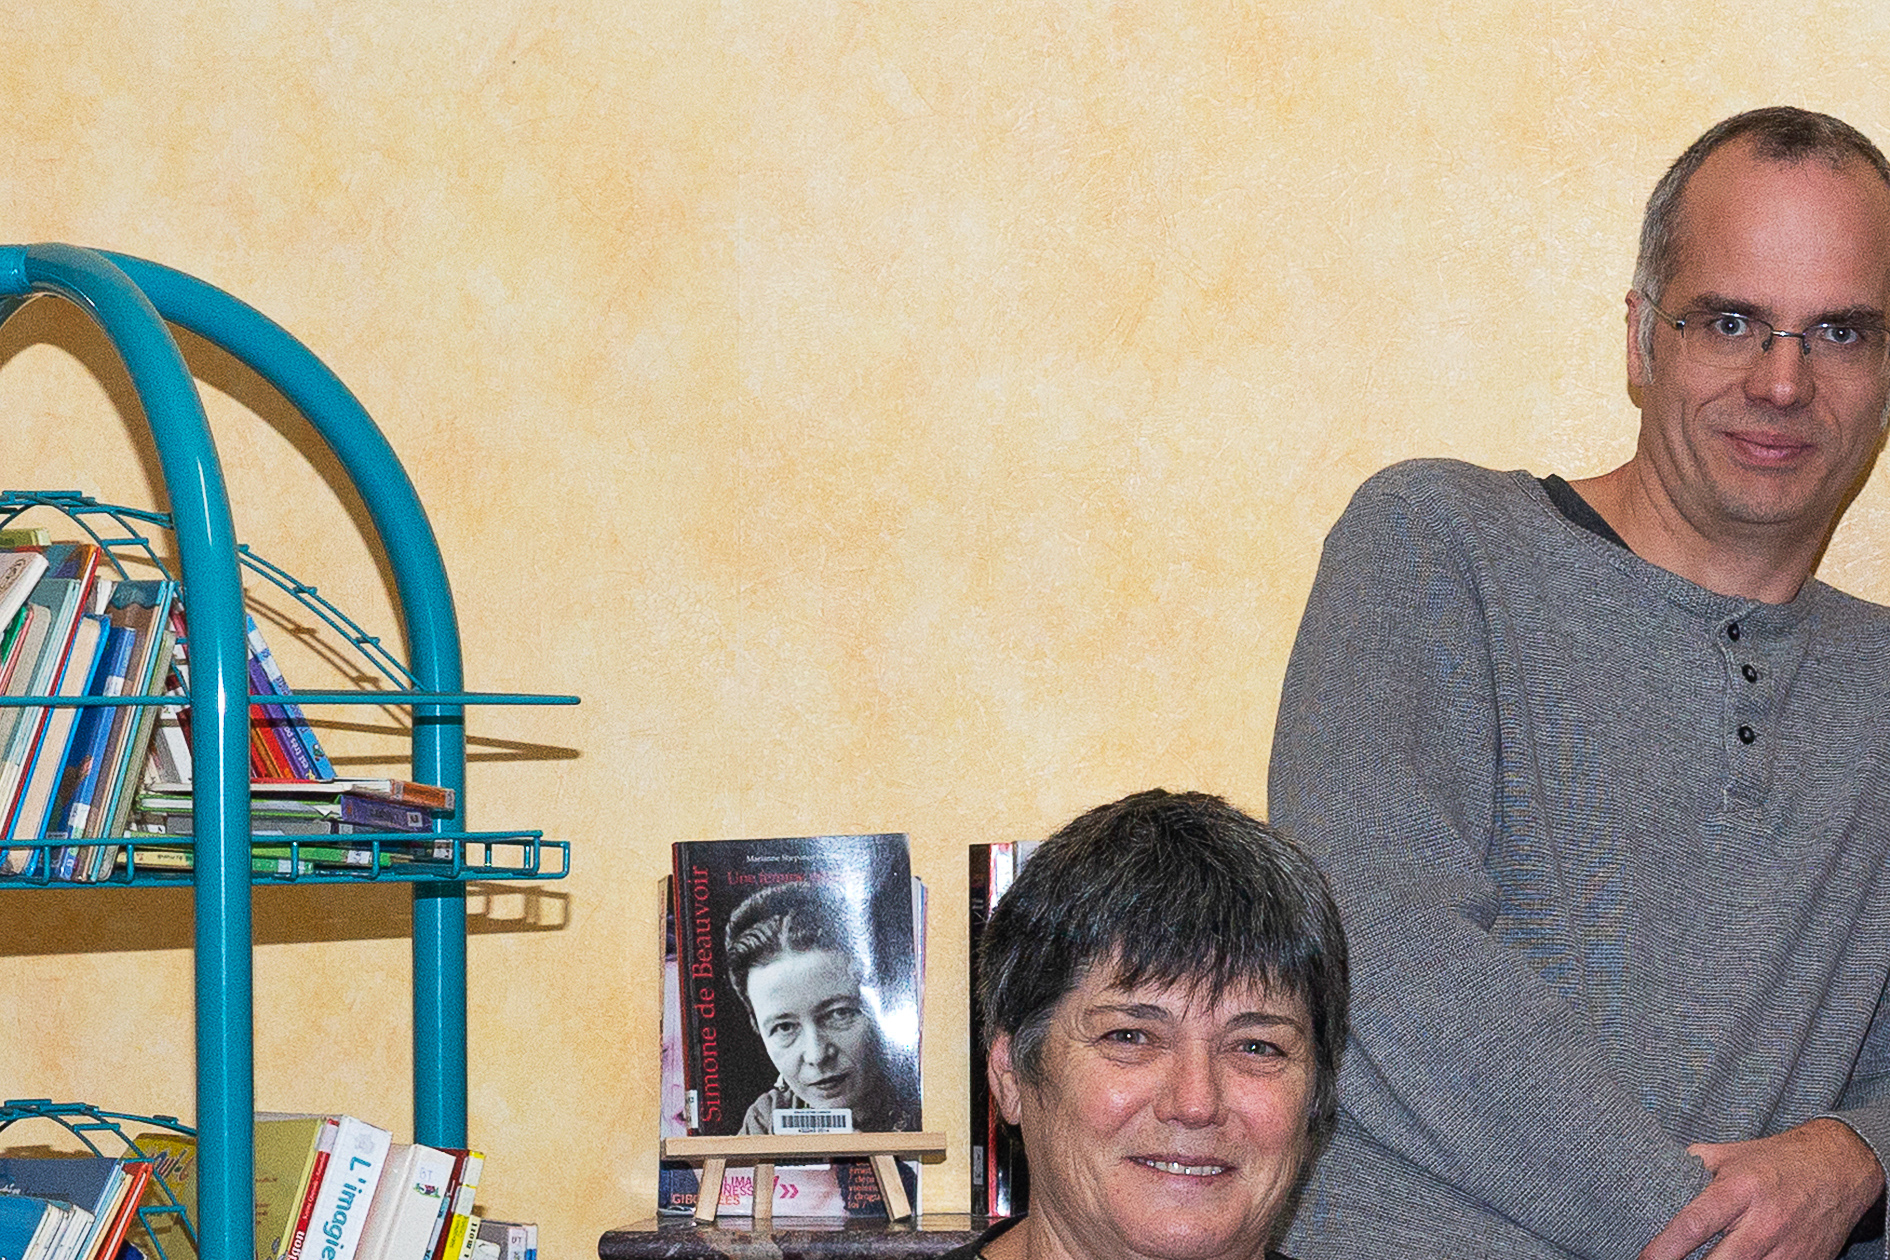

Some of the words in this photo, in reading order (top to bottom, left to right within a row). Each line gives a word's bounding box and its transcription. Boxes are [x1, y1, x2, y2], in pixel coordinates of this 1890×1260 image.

[687, 865, 713, 980] Beauvoir
[695, 987, 716, 1019] de
[701, 1026, 721, 1123] Simone
